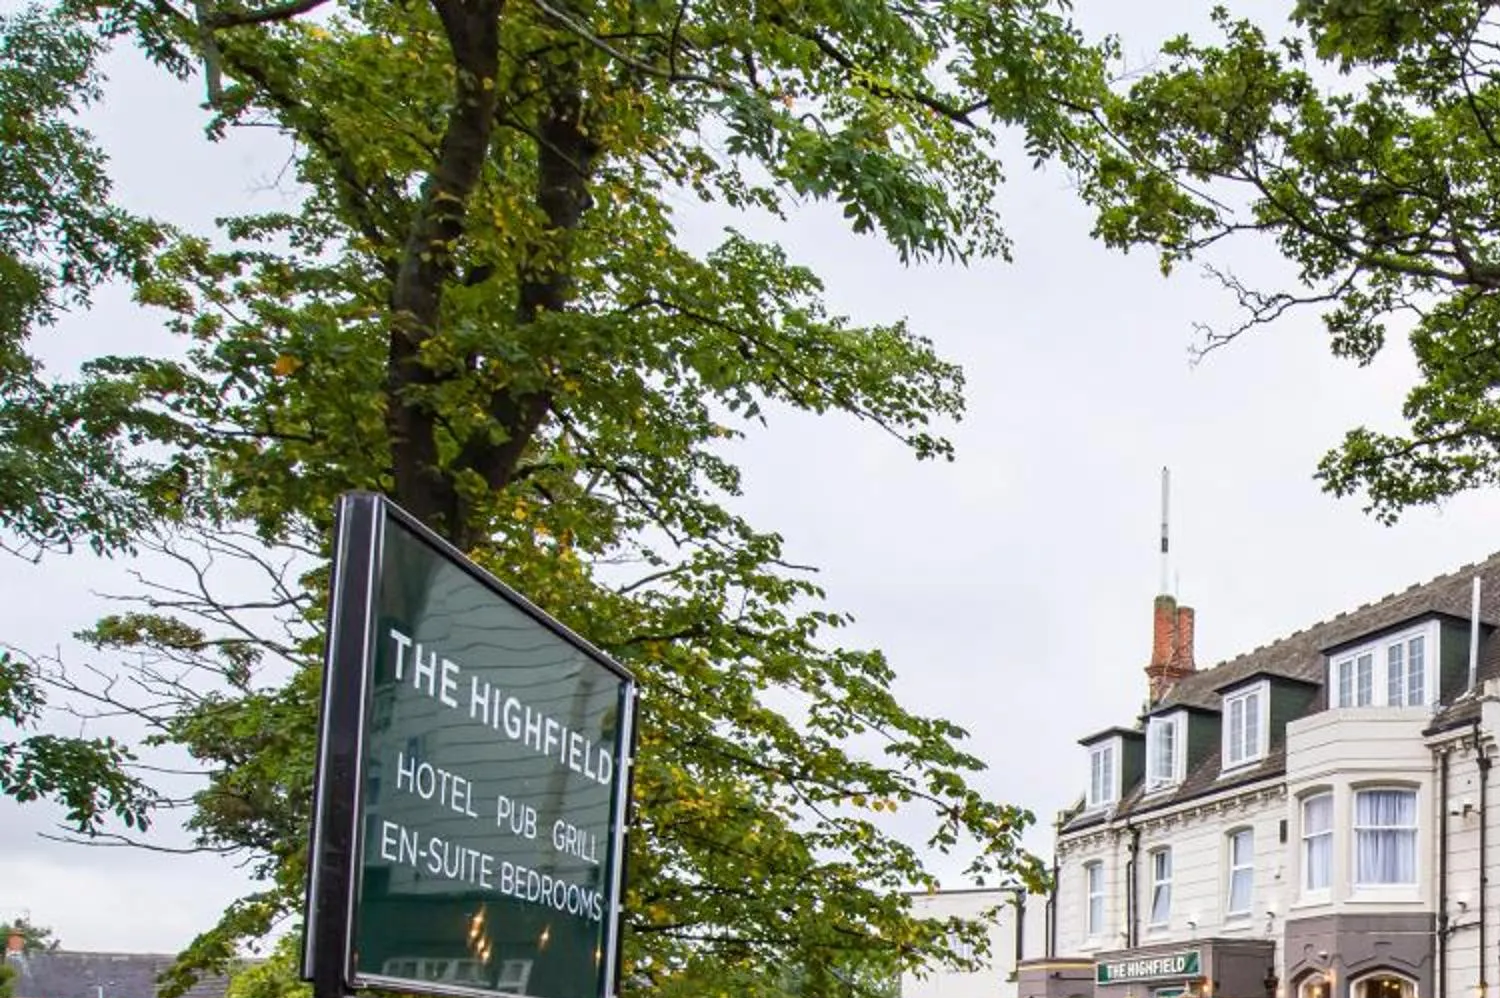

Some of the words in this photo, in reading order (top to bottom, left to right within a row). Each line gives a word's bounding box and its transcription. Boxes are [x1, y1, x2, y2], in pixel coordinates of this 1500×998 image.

[390, 629, 459, 709] THE
[470, 675, 613, 786] HIGHFIELD
[396, 752, 478, 818] HOTEL
[497, 795, 538, 840] PUB
[552, 818, 600, 865] GRILL
[381, 819, 493, 890] EN-SUITE
[501, 860, 602, 922] BEDROOMS
[1106, 963, 1126, 979] THE
[1127, 956, 1185, 977] HIGHFIELD
